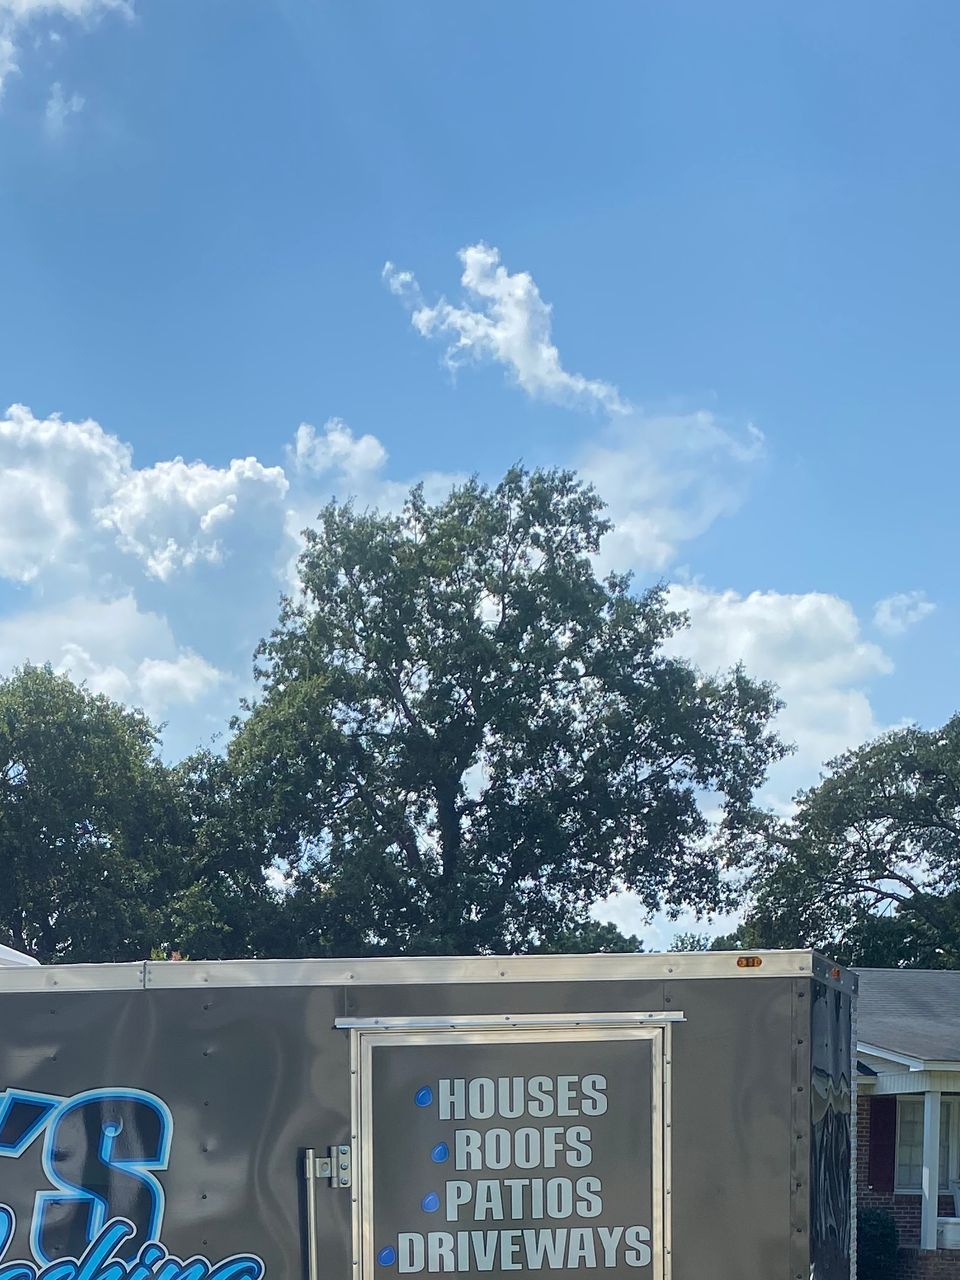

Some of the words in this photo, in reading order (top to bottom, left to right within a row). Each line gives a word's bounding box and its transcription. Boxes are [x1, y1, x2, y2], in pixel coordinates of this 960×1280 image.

[438, 1074, 608, 1120] HOUSES
[454, 1126, 592, 1171] ROOFS
[445, 1176, 602, 1221] PATIOS
[397, 1225, 651, 1273] DRIVEWAYS
